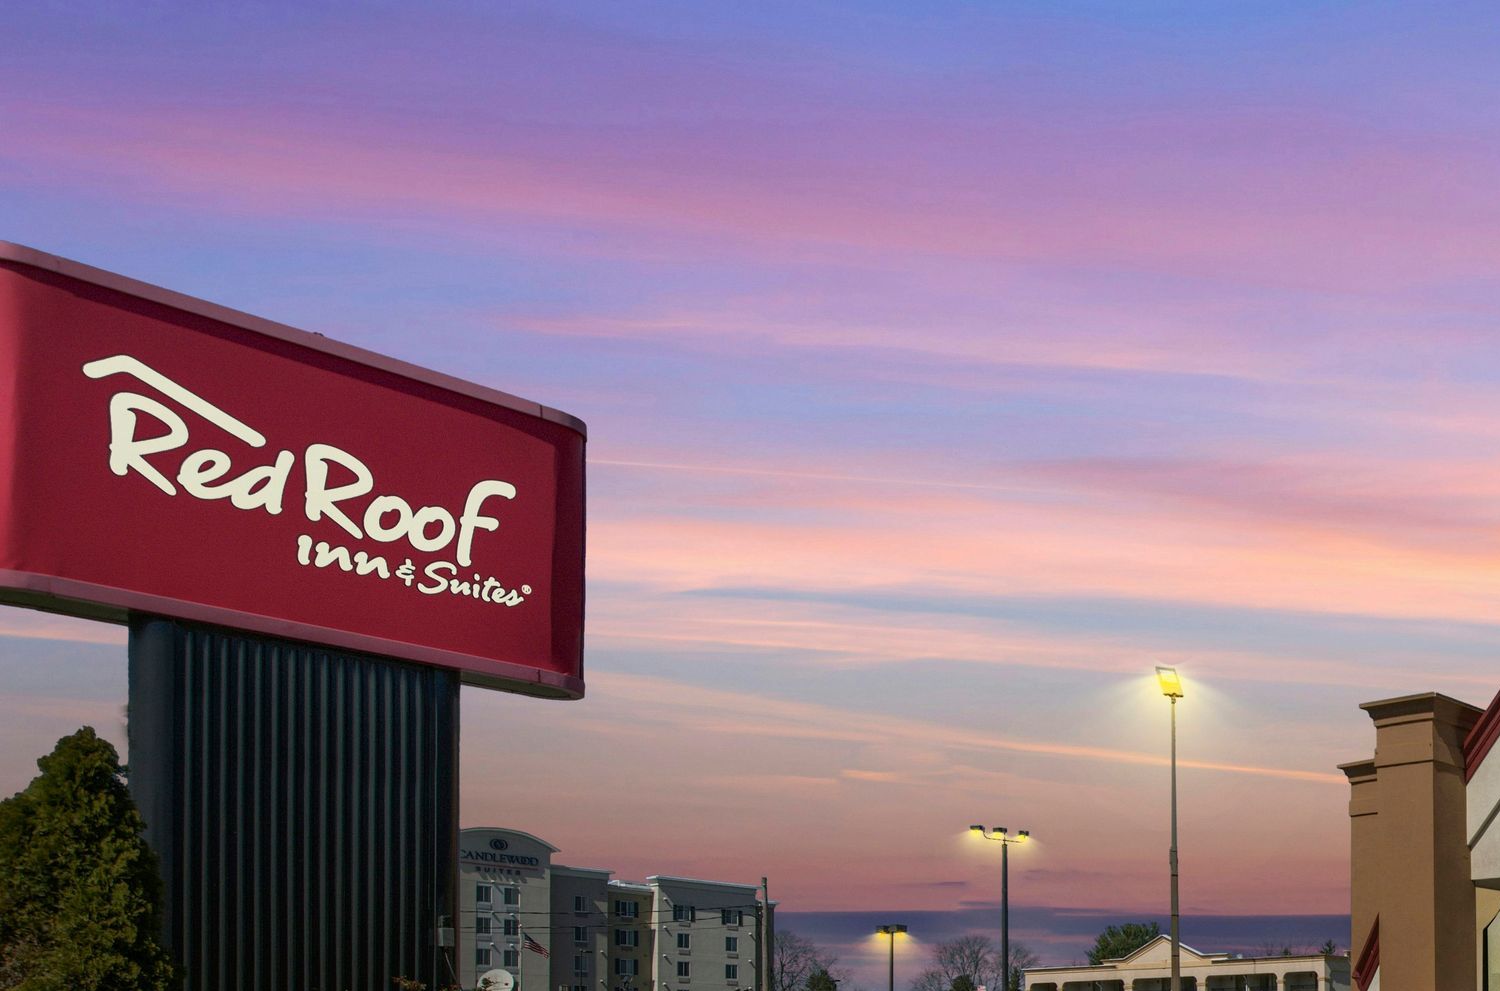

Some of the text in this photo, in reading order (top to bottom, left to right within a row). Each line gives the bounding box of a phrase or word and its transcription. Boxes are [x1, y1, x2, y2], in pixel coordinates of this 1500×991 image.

[108, 391, 518, 568] Red Roof
[297, 534, 391, 580] Inn
[395, 558, 416, 587] &
